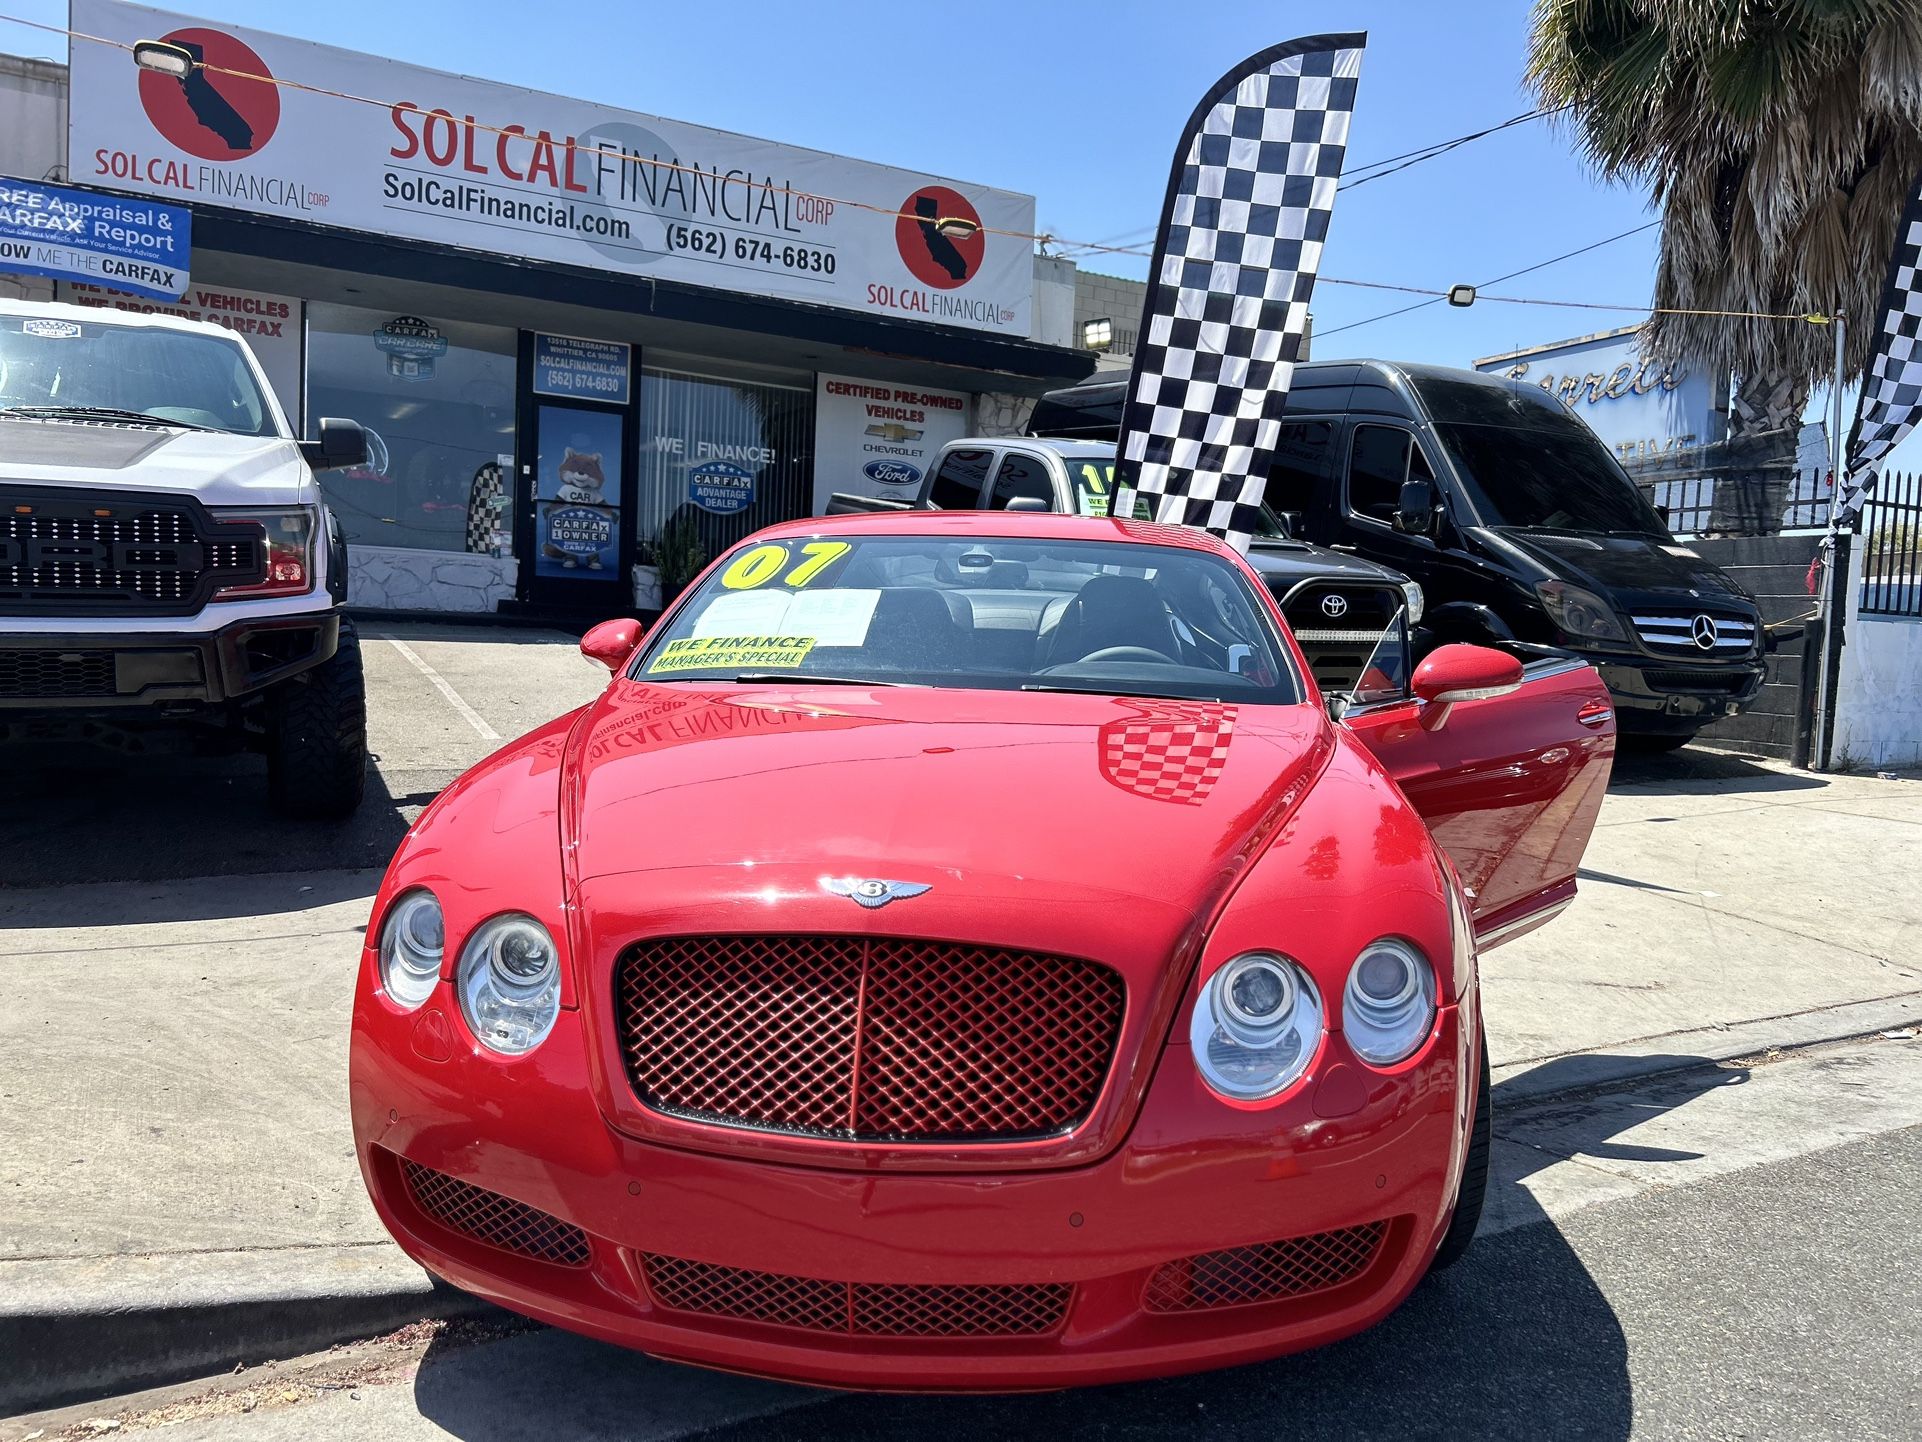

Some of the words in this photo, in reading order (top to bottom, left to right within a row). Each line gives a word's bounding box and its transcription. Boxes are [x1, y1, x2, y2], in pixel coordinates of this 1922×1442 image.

[199, 166, 312, 211] FINANCIAL
[307, 191, 330, 208] CORP
[596, 142, 801, 233] FINANCIAL
[796, 195, 834, 225] CORP
[48, 196, 153, 226] Appraisal
[157, 213, 173, 231] &
[383, 172, 631, 240] SolCalFinancial.com
[90, 239, 106, 248] Your
[107, 243, 133, 253] Service
[94, 221, 174, 252] Report
[666, 223, 726, 260] (562)
[734, 237, 836, 275] 674-6830
[36, 247, 62, 265] ME
[66, 251, 98, 271] THE
[102, 259, 175, 288] CARFAX
[196, 291, 289, 319] VEHICLES
[931, 294, 1003, 325] FINANCIAL
[1000, 310, 1015, 321] CORP
[386, 326, 438, 339] CARFAX
[569, 340, 608, 352] TELEGRAPH
[540, 355, 626, 377] SOLCALFINANCIAL.COM
[548, 370, 572, 390] (562)
[575, 374, 619, 393] 674-6830
[826, 380, 891, 401] CERTIFIED
[894, 390, 963, 411] PRE-OWNED
[865, 404, 925, 423] VEHICLES
[655, 436, 684, 454] WE
[697, 441, 776, 464] FINANCE!
[863, 443, 925, 458] CHEVROLET
[694, 475, 751, 489] CARFAX
[874, 461, 910, 483] Ford
[570, 491, 591, 501] CAR
[697, 488, 747, 500] ADVANTAGE
[705, 498, 738, 509] DEALER
[553, 519, 608, 532] CARFAX
[721, 542, 852, 590] 07
[667, 638, 704, 653] WE
[706, 636, 812, 650] FINANCE
[654, 651, 736, 668] MANAGER'S
[737, 651, 802, 664] SPECIAL
